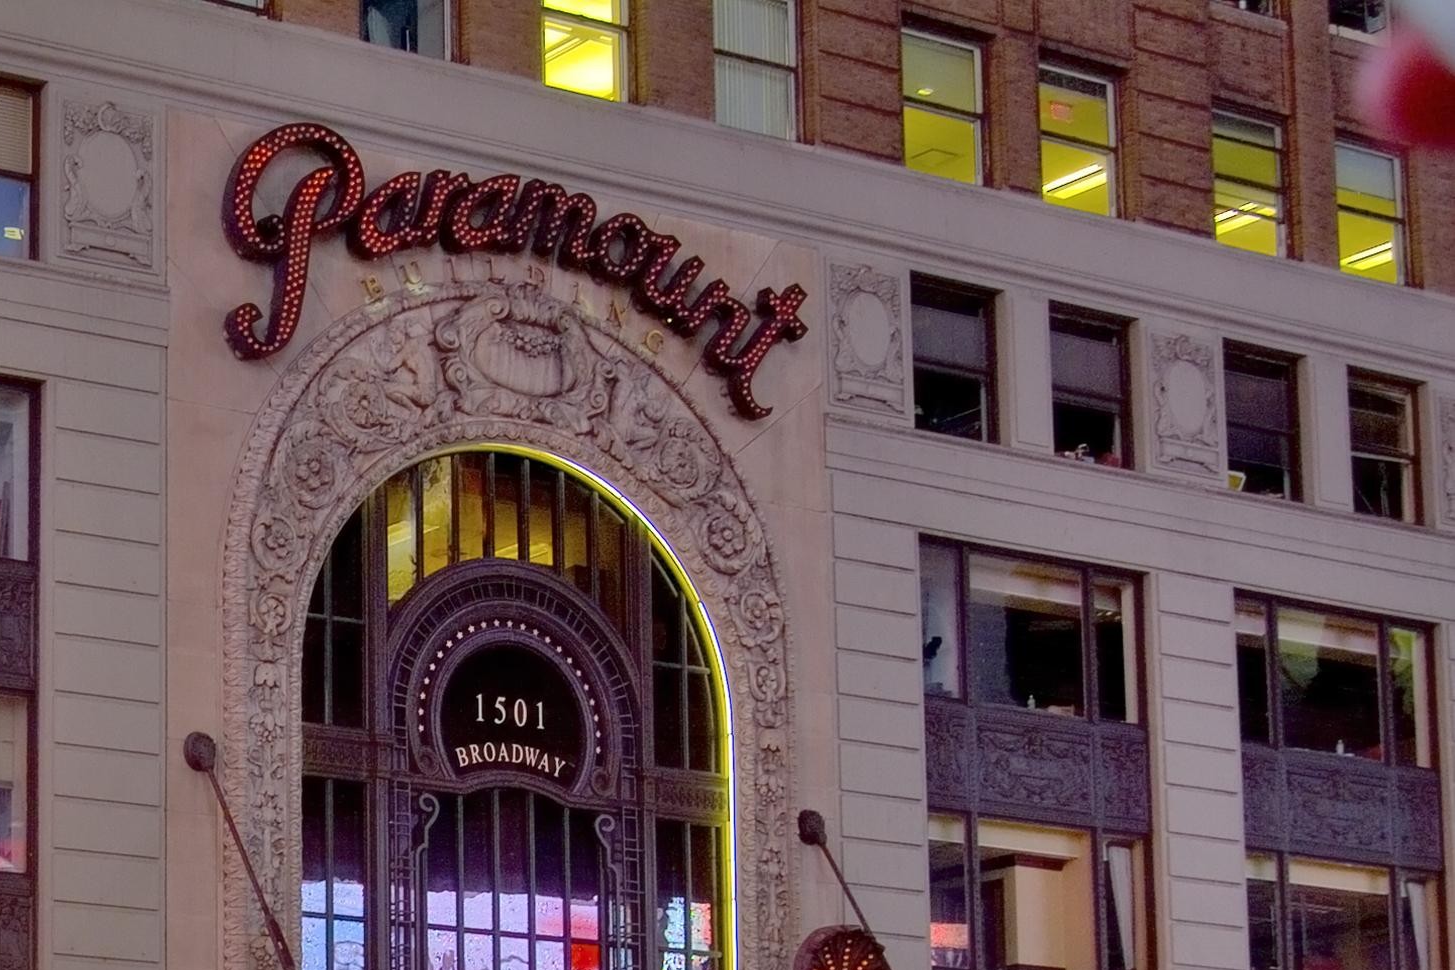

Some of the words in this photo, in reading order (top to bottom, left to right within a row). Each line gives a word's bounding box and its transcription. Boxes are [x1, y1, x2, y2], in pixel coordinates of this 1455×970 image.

[223, 122, 808, 421] Paramount
[360, 257, 666, 354] BUILDING
[476, 693, 545, 730] 1501
[455, 741, 566, 778] BROADWAY
